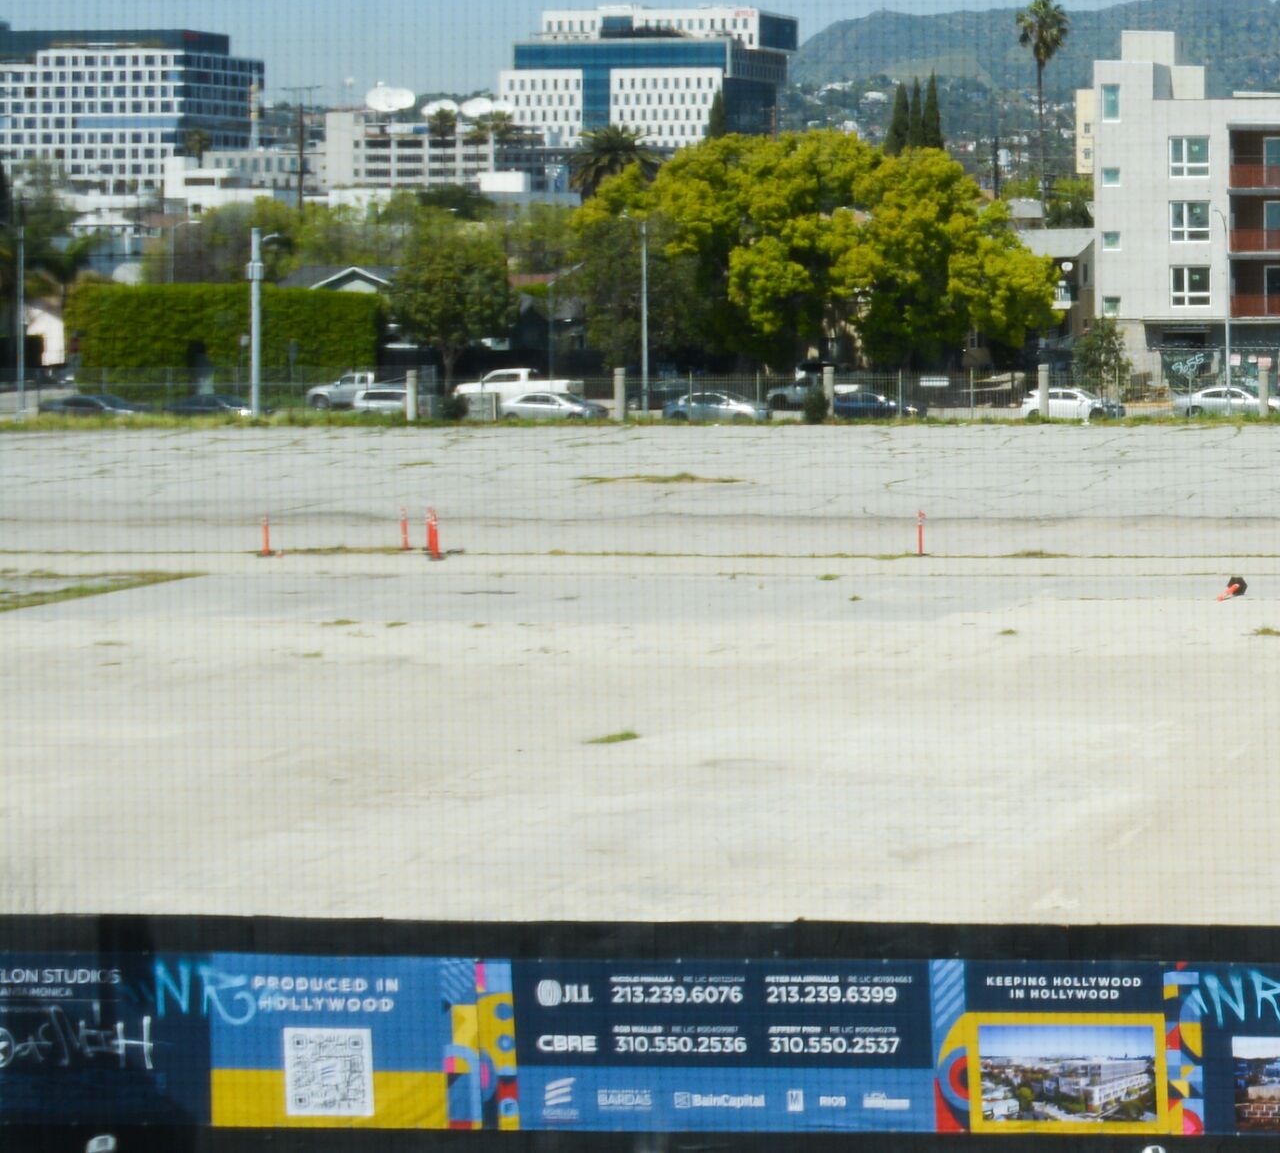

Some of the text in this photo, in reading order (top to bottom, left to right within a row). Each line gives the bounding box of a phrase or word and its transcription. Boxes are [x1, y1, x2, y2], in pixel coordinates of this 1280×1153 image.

[253, 975, 399, 992] PRODUCED IN
[986, 976, 1142, 987] KEEPING HOLLYWOOD
[562, 984, 593, 1003] JLL
[611, 986, 743, 1003] 213.239.6076
[766, 986, 897, 1003] 213.239.6399
[1010, 989, 1120, 999] IN HOLLYWOOD
[259, 996, 394, 1012] HOLLYWOOD
[538, 1034, 597, 1052] CBRE
[614, 1036, 747, 1053] 310.550.2536
[769, 1037, 900, 1054] 310.550.2537
[598, 1094, 652, 1106] BARDAS
